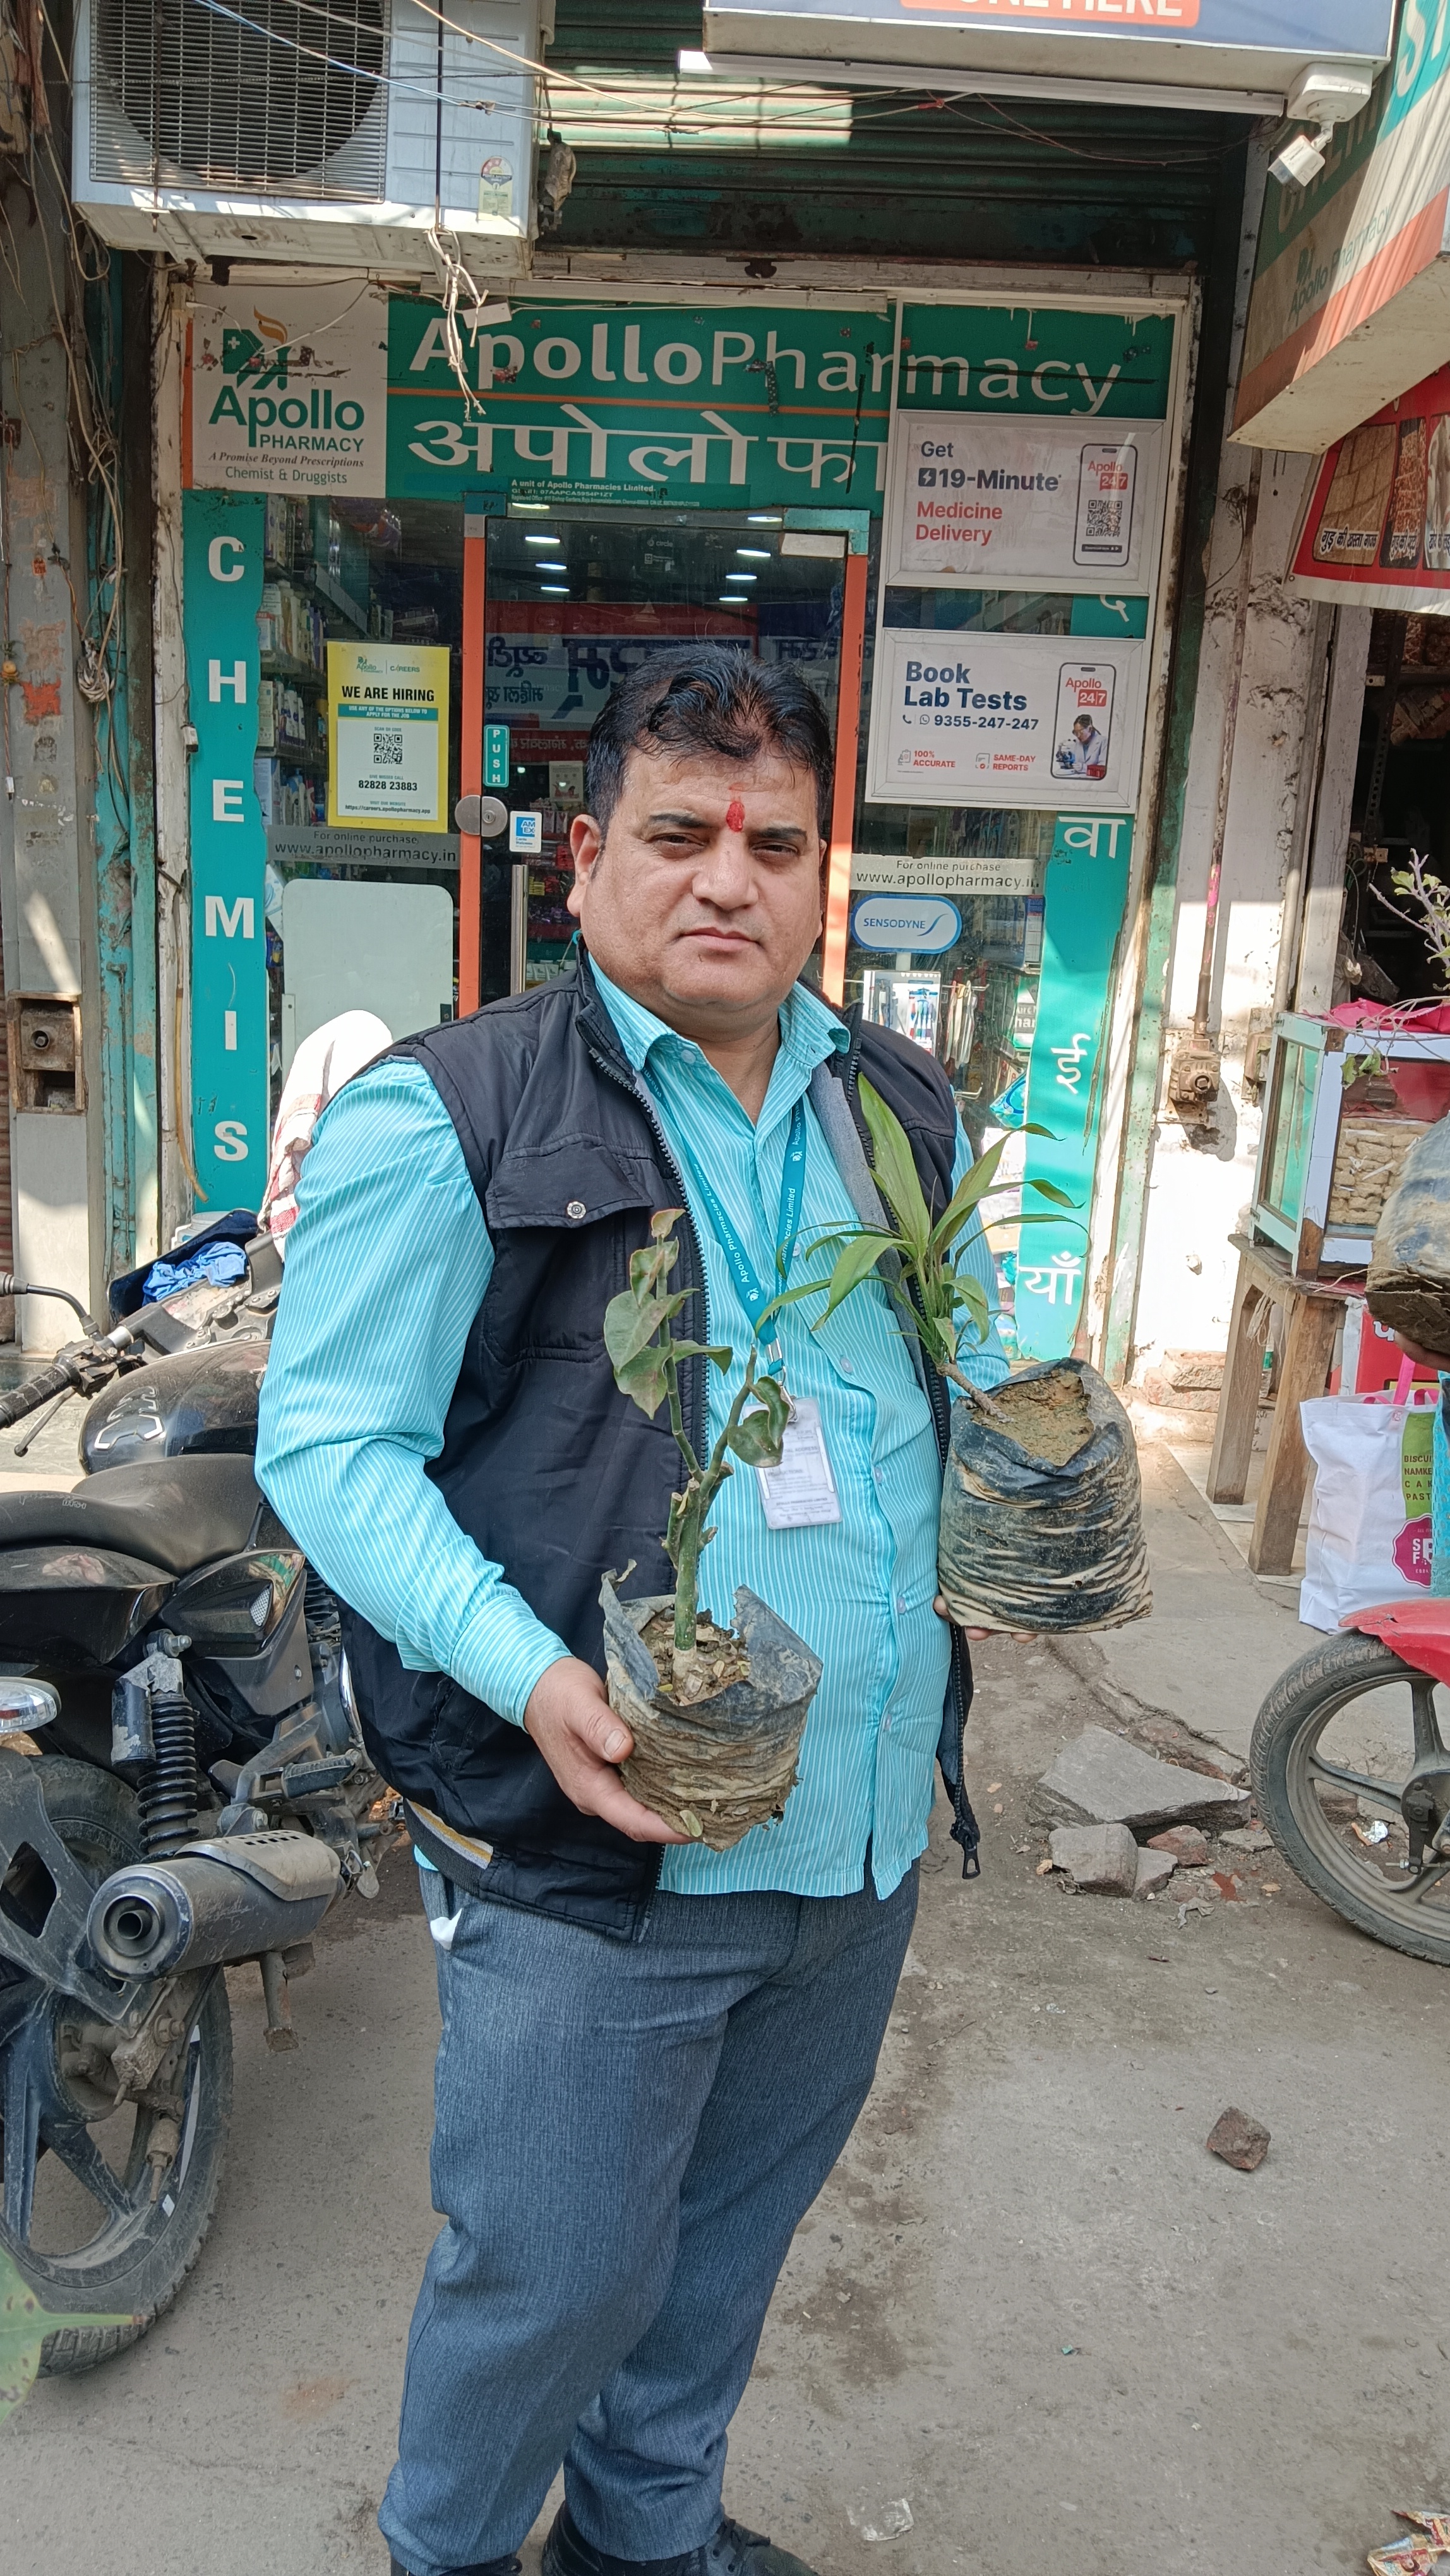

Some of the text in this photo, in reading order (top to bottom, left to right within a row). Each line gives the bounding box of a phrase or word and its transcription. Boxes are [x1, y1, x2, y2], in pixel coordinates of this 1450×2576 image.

[208, 385, 365, 448] Apollo
[260, 434, 364, 452] PHARMACY
[408, 404, 759, 485] अपोलो
[921, 441, 954, 458] Get
[208, 452, 364, 469] A Promise Beyond Prescriptions
[1088, 461, 1123, 477] Apollo
[225, 466, 347, 485] Chemist & Druggists
[548, 481, 572, 490] Apollo
[575, 482, 621, 491] Pharmacies
[917, 501, 1003, 519] Medicine
[916, 524, 992, 546] Delivery
[356, 664, 376, 673] Apollo
[906, 661, 971, 684] Book
[342, 686, 434, 701] WE ARE HIRING
[1065, 677, 1102, 693] Apollo
[904, 686, 1028, 711] Lab Tests
[934, 715, 1039, 730] 9355-247-247
[492, 729, 501, 783] PUSH
[914, 750, 935, 758] 100%
[993, 754, 1036, 763] SAME-DAY
[913, 760, 956, 768] ACCURATE
[993, 763, 1029, 772] REPORTS
[359, 780, 417, 790] 82828 23883
[314, 831, 330, 840] For
[334, 832, 366, 842] online
[275, 844, 457, 863] www.apollopharmacy.in
[897, 860, 1001, 873] For online purchase
[856, 871, 1039, 888] www.apollopharmacy.in
[864, 917, 926, 929] SENSODYNE
[786, 1187, 796, 1218] Limited
[693, 1163, 750, 1283] Apollo Pharmacies Limited
